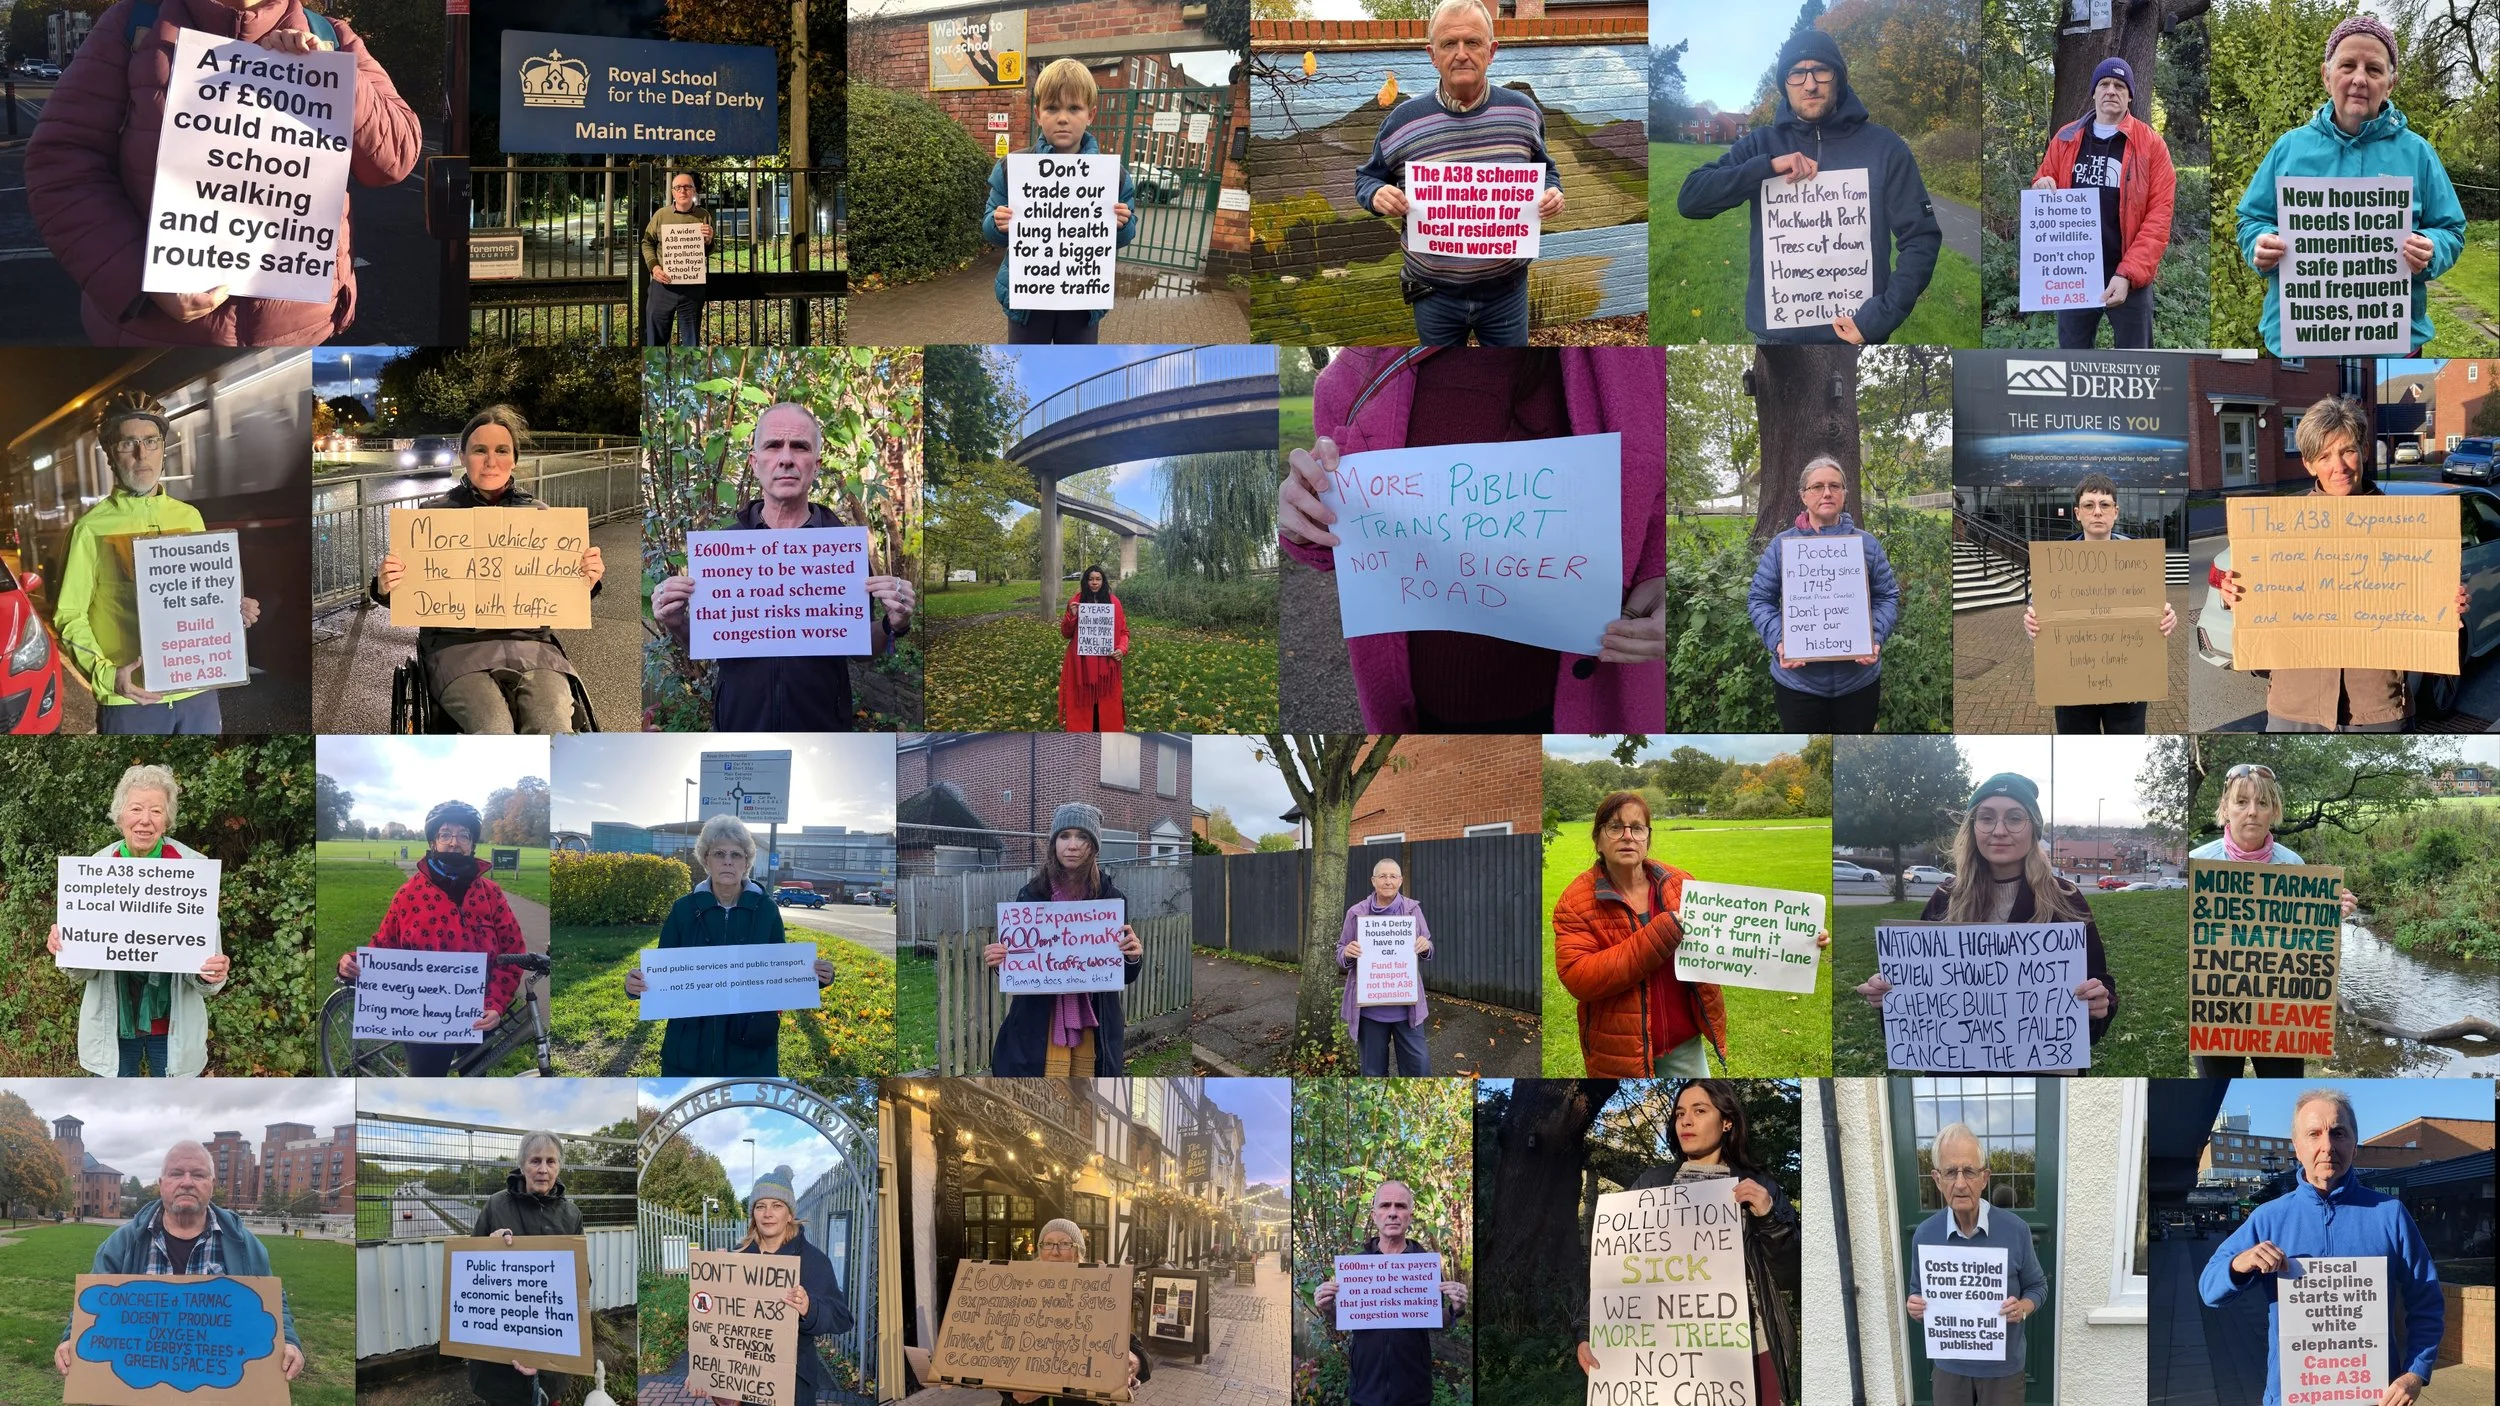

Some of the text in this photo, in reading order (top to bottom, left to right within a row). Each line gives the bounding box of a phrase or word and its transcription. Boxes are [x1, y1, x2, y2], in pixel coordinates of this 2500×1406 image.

[934, 20, 1003, 38] Welcome to
[935, 36, 992, 55] our school
[197, 49, 338, 88] A fraction
[608, 67, 717, 86] Royal School
[199, 81, 332, 119] of £600m
[608, 87, 764, 110] for the Deaf Derby
[174, 112, 347, 152] could make
[576, 123, 716, 141] Main Entrance
[207, 148, 310, 178] school
[1412, 166, 1538, 182] The A38 scheme
[2076, 174, 2103, 185] FACE
[196, 180, 311, 216] walking
[1415, 186, 1534, 201] will make noise
[2039, 194, 2087, 203] This Oak
[1427, 205, 1520, 220] pollution for
[2035, 206, 2091, 216] is home to
[160, 210, 334, 250] and cycling
[1418, 221, 1528, 237] local residents
[2030, 219, 2096, 230] 3,000 species
[2035, 232, 2092, 242] of wildlife.
[1429, 240, 1517, 254] even worse!
[153, 245, 335, 277] routes safer
[2034, 252, 2095, 263] Don't chop
[2042, 266, 2087, 276] it down.
[2045, 279, 2084, 290] Cancel
[2042, 293, 2088, 305] the A38.
[2071, 362, 2160, 375] UNIVERSITY OF
[2071, 375, 2160, 399] DERBY
[2008, 413, 2160, 431] THE FUTURE IS YOU
[1335, 463, 1554, 507] MORE PUBLIC
[1351, 510, 1567, 541] TRANSPORT
[1351, 551, 1587, 579] NOT A BIGGER
[1401, 577, 1507, 608] ROAD
[1087, 627, 1097, 635] THE
[1102, 638, 1112, 646] THE
[670, 965, 694, 973] public
[746, 961, 768, 970] public
[731, 980, 764, 988] pointless
[638, 1084, 858, 1163] PEARTREE STATION
[1925, 1260, 2002, 1275] Costs tripled
[1927, 1274, 2002, 1287] from £220m
[1926, 1289, 2003, 1300] to over £600m
[1935, 1316, 1997, 1328] Still no Full
[1928, 1328, 2004, 1340] Business Case
[1940, 1340, 1993, 1350] published
